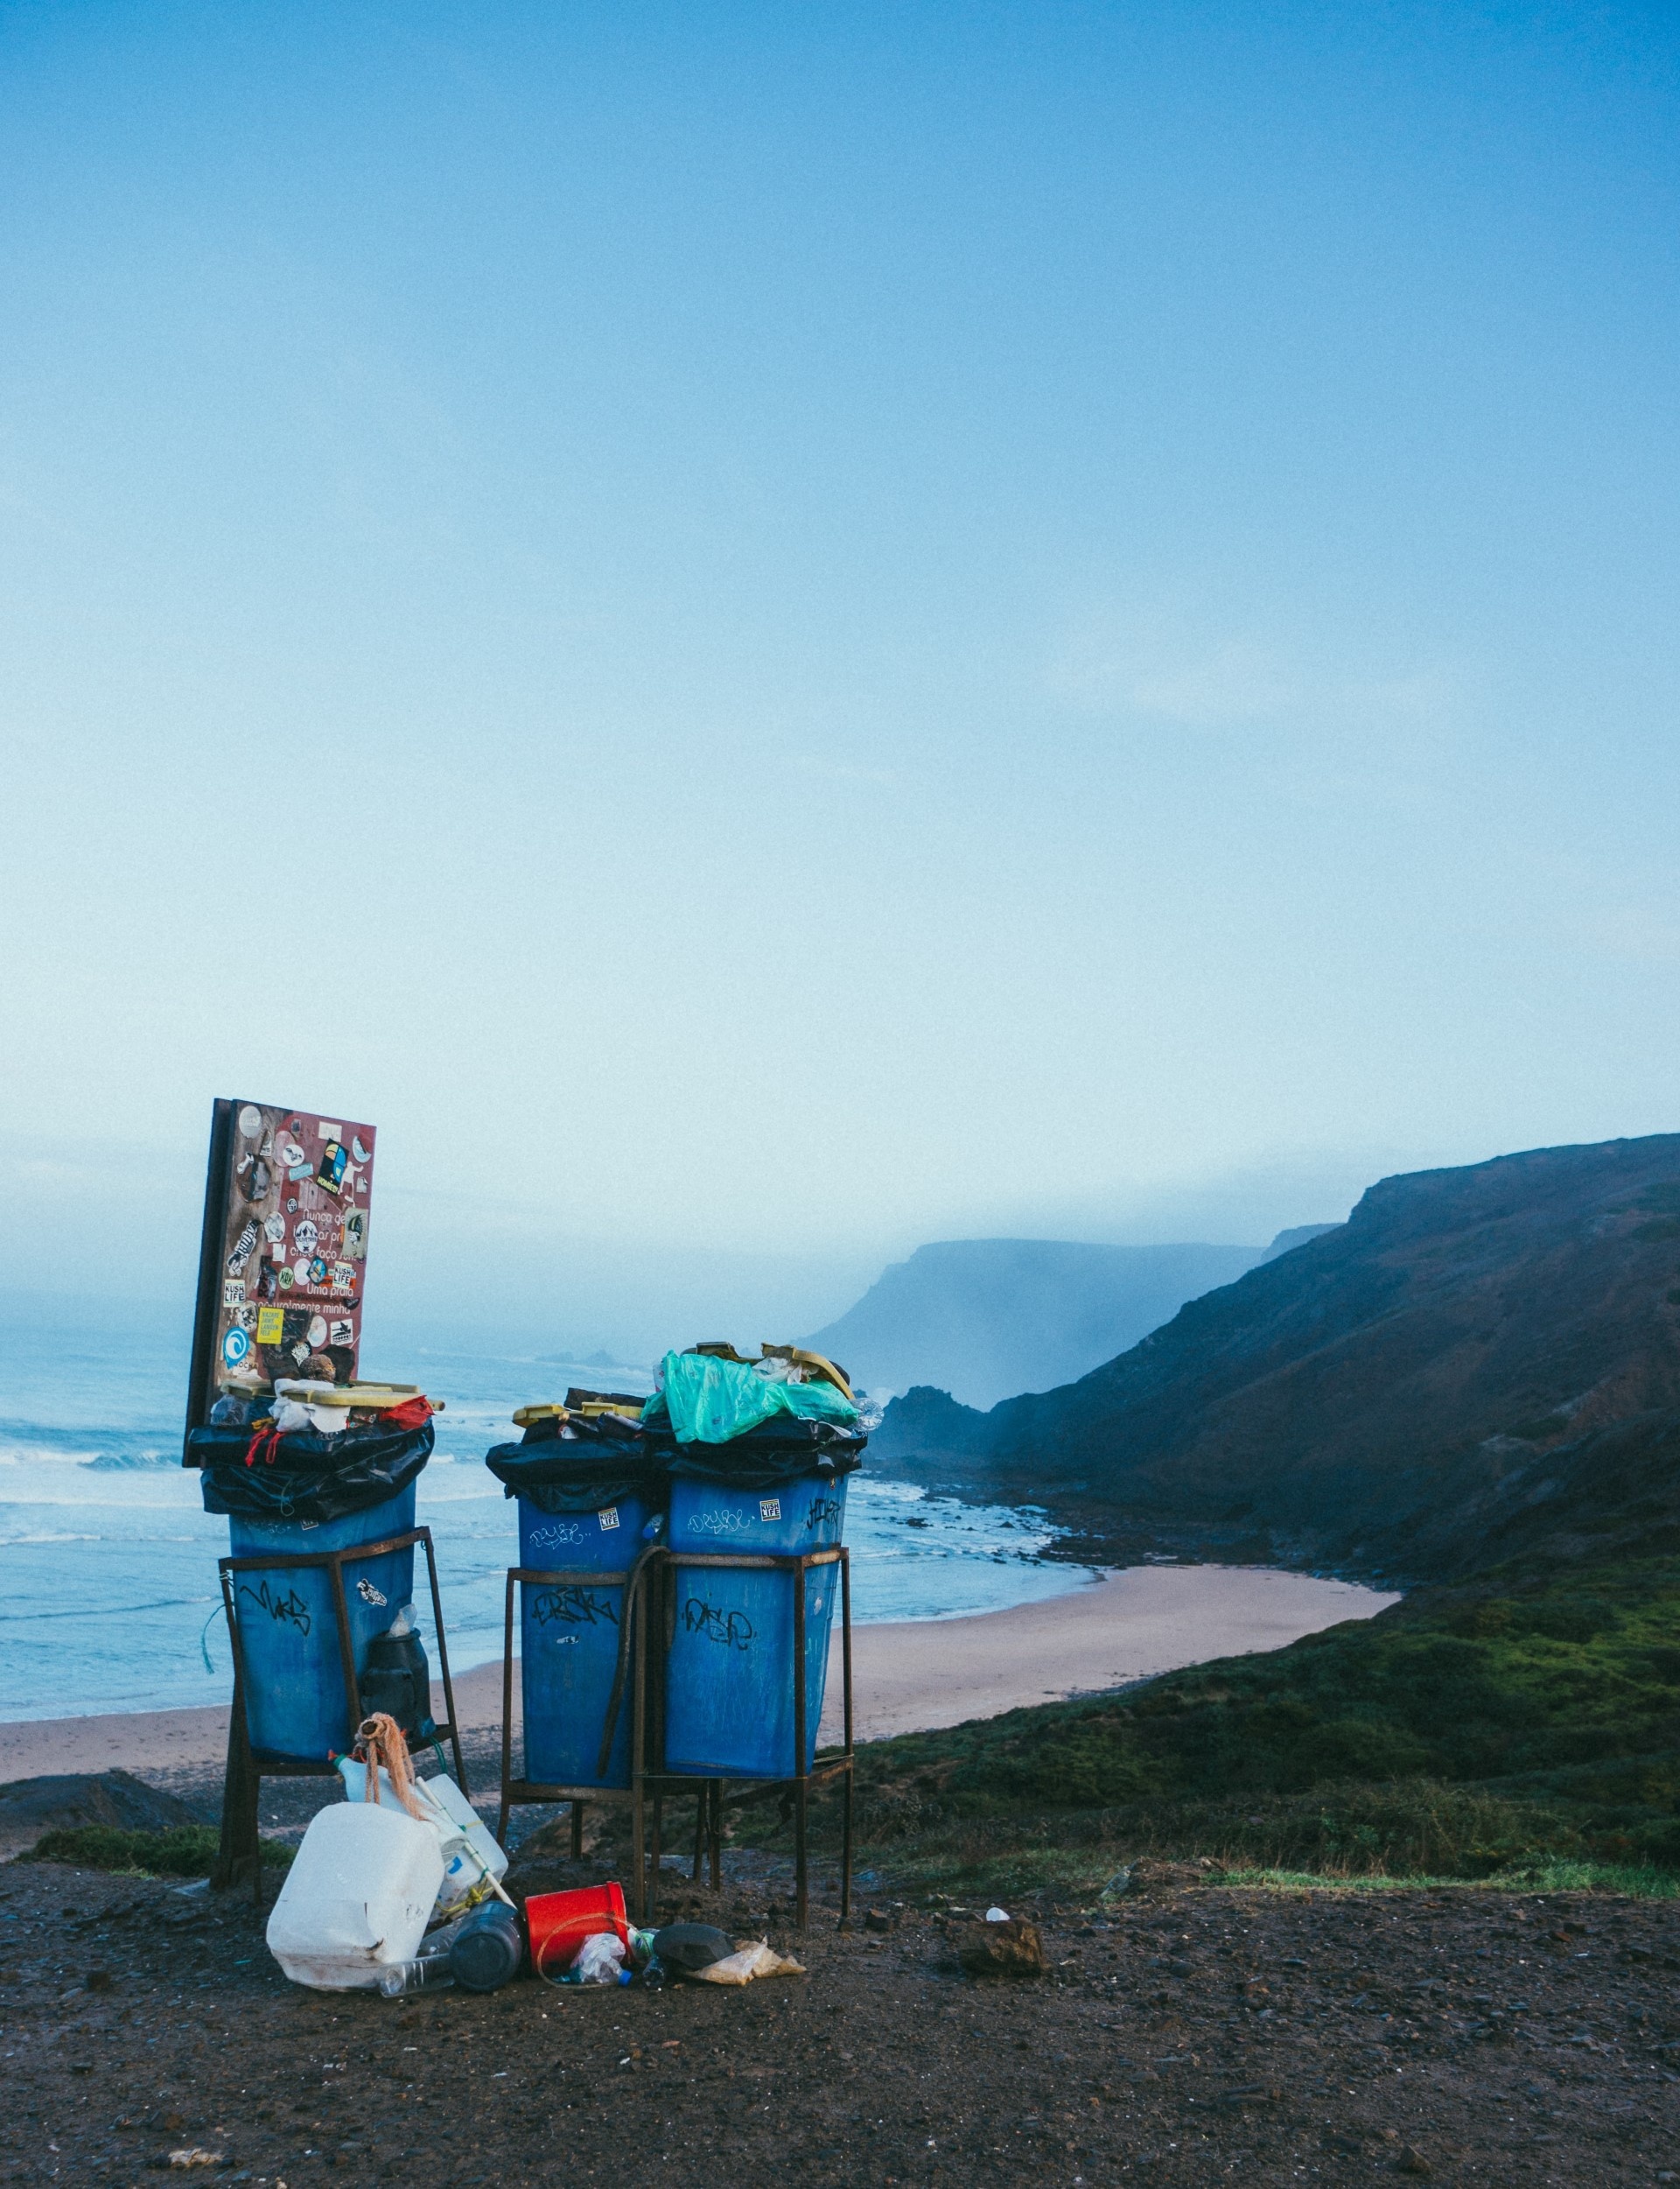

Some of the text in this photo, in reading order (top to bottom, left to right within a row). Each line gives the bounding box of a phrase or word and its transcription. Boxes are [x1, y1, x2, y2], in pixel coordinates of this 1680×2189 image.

[303, 1209, 346, 1226] Nunca de
[318, 1231, 329, 1240] as
[335, 1267, 350, 1276] KUSH
[334, 1273, 350, 1284] LIFE
[306, 1283, 328, 1296] Uma
[330, 1287, 354, 1299] praia
[225, 1293, 245, 1301] LIFE
[323, 1302, 351, 1315] minha
[600, 1512, 617, 1520] KUSH
[601, 1518, 618, 1526] LIFE
